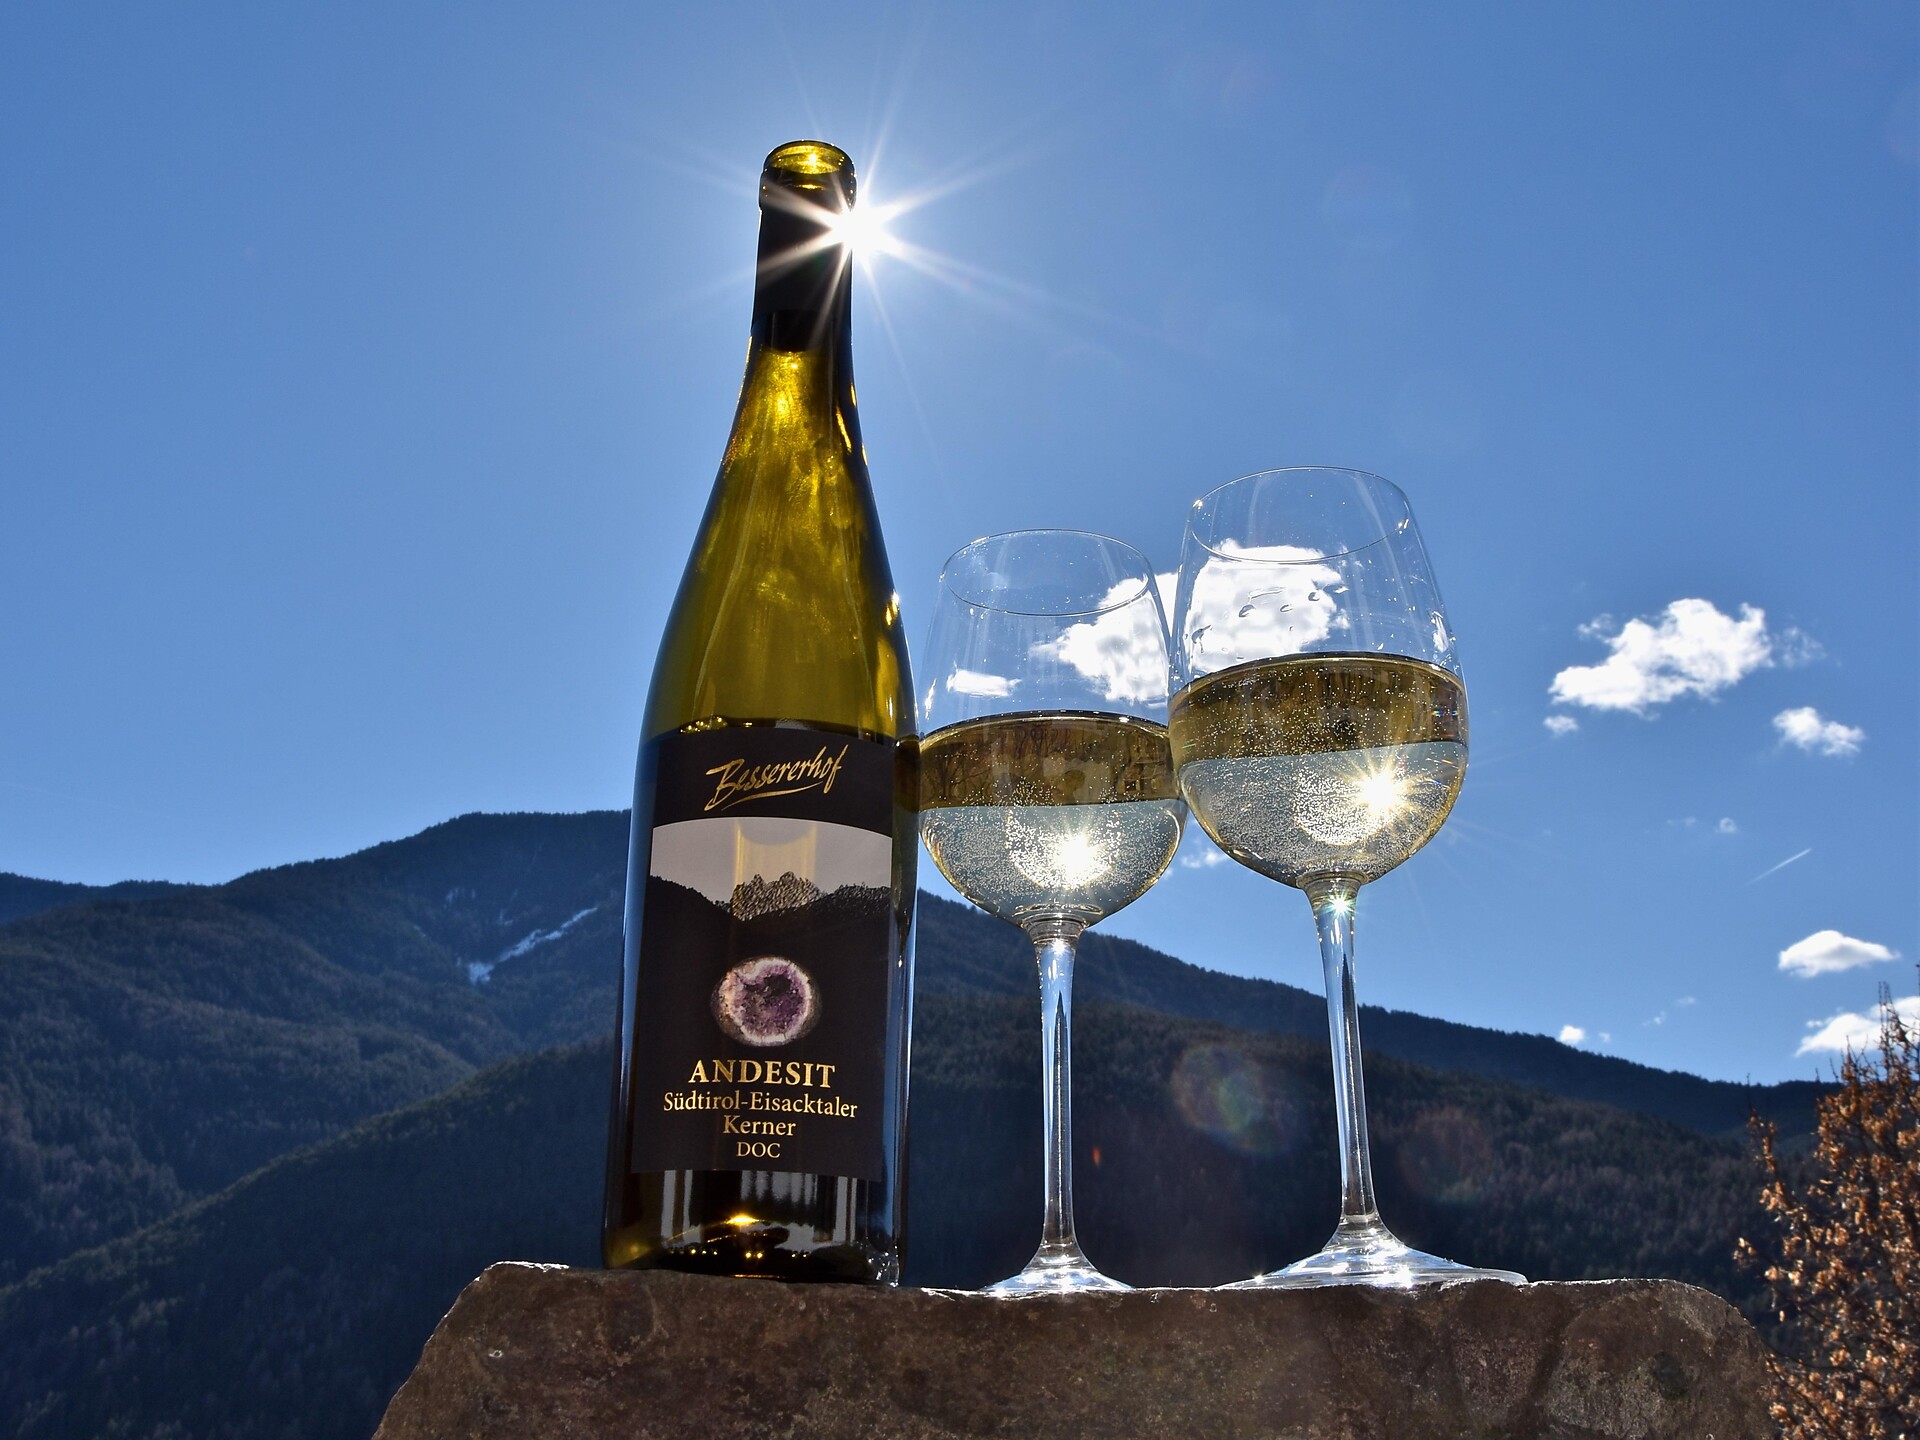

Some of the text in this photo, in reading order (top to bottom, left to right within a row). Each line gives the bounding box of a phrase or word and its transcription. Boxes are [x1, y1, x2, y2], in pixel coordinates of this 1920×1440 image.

[703, 744, 849, 811] Bessererhof
[688, 1059, 836, 1088] ANDESIT
[663, 1091, 858, 1119] Südtirol-Eisacktaler
[722, 1115, 796, 1136] Kerner
[735, 1141, 781, 1159] DOC
